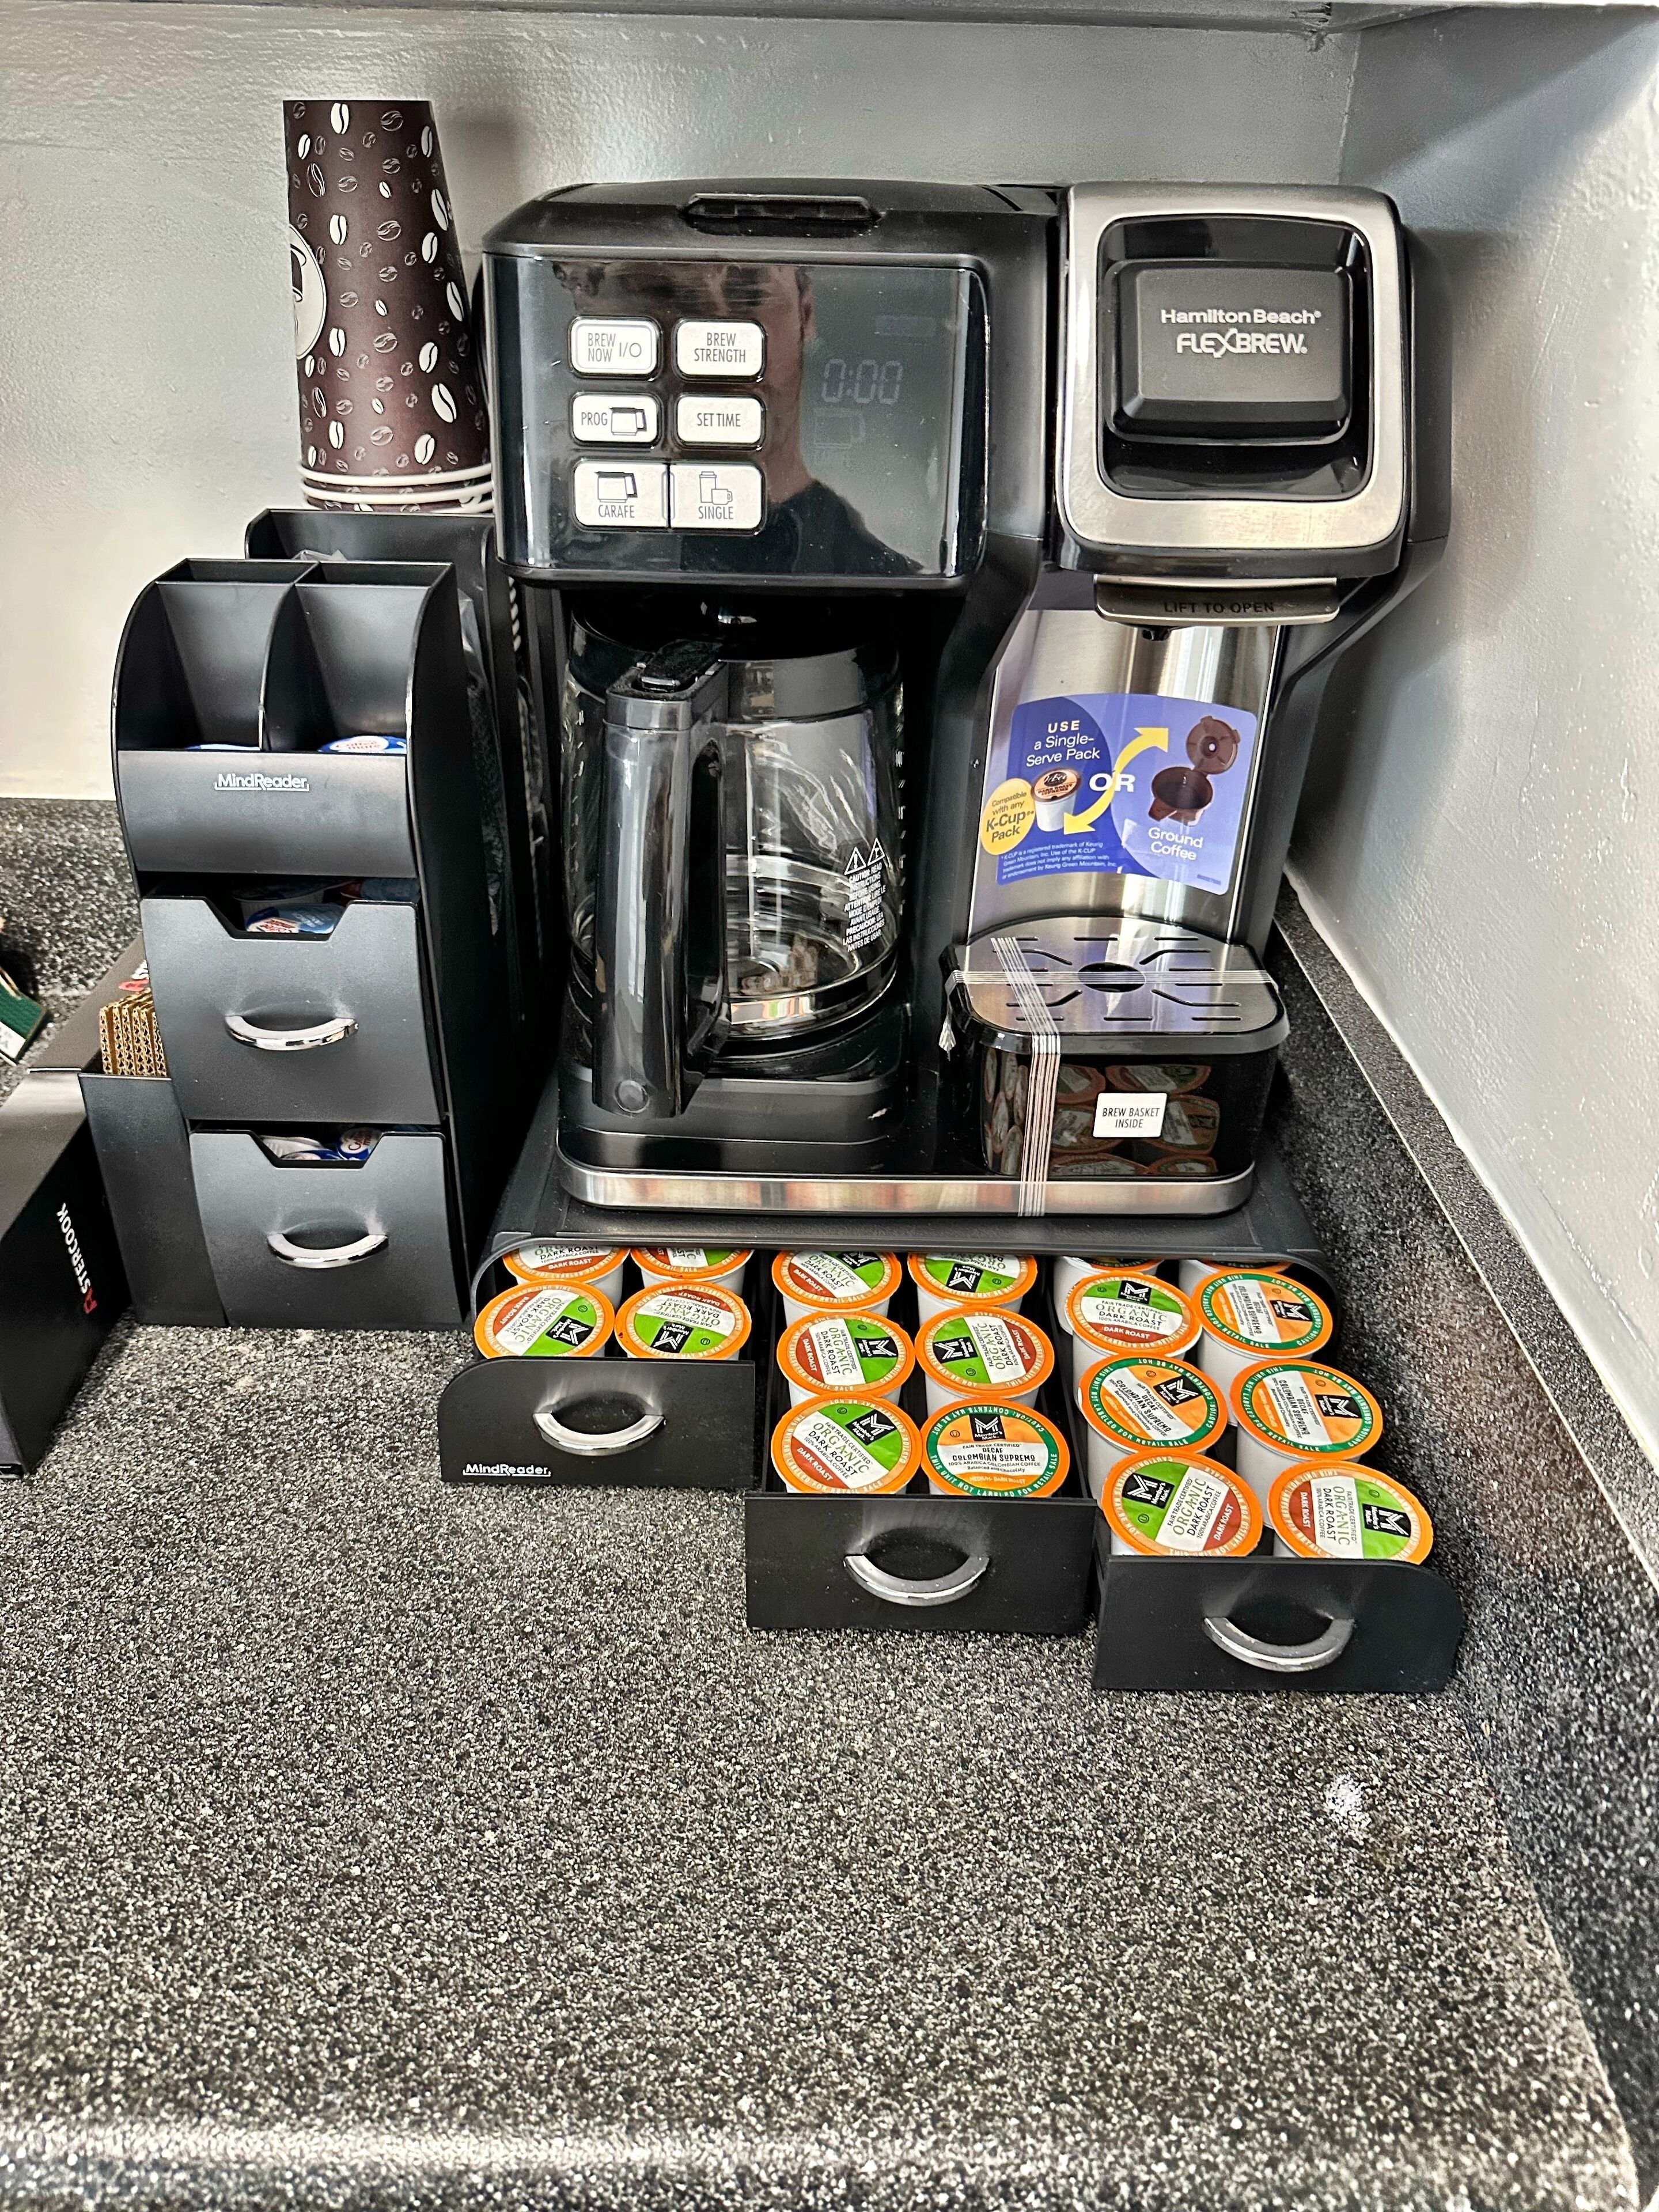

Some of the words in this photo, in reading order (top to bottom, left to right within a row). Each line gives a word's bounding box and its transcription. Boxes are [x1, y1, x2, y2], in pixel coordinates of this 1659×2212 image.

[1161, 309, 1251, 323] Hamilton
[588, 333, 616, 347] BREW
[707, 332, 736, 346] BREW
[588, 349, 612, 362] NOW
[694, 348, 745, 362] STRENGTH
[581, 411, 608, 426] PROG
[697, 413, 714, 426] SET
[715, 413, 741, 427] TIME
[598, 505, 635, 518] CARAFE
[698, 506, 733, 519] SINGLE
[1164, 602, 1196, 613] LIFT
[1203, 603, 1225, 613] TO
[1230, 602, 1274, 613] OPEN
[1048, 720, 1080, 733] USE
[1034, 741, 1041, 750] a
[1046, 733, 1094, 748] Single-
[1027, 752, 1062, 767] Serve
[1066, 748, 1100, 760] Pack
[218, 773, 308, 791] MindReader
[1089, 773, 1135, 792] OR
[992, 791, 1027, 806] Compatible
[992, 805, 1009, 816] with
[1010, 800, 1025, 810] any
[991, 825, 1021, 843] Pack
[1149, 827, 1203, 848] Ground
[1151, 841, 1196, 860] Coffee
[850, 872, 881, 892] INSTRUCTIONS
[850, 914, 865, 926] AVANT
[866, 906, 880, 919] USAGE
[843, 935, 853, 945] LAS
[848, 940, 863, 952] ANTES
[864, 937, 870, 945] DE
[1103, 1108, 1127, 1117] BREW
[1128, 1108, 1160, 1117] BASKET
[1115, 1119, 1143, 1128] INSIDE
[56, 1202, 91, 1294] STERCOOK
[548, 1262, 568, 1270] DARK
[569, 1258, 592, 1266] ROAST
[793, 1269, 808, 1281] DARK
[806, 1278, 824, 1291] ROAST
[805, 1260, 820, 1272] DARK
[821, 1268, 844, 1287] ROAST
[514, 1296, 529, 1310] DARK
[533, 1298, 551, 1313] DARK
[662, 1301, 692, 1310] ROAST
[499, 1308, 517, 1325] ROAST
[695, 1308, 719, 1319] DARK
[1129, 1315, 1162, 1326] ROAST
[510, 1314, 533, 1336] ROAST
[989, 1325, 1004, 1344] ROAST
[1012, 1330, 1022, 1345] ROAST
[1125, 1330, 1150, 1339] ROAST
[802, 1338, 812, 1354] DARK
[807, 1354, 817, 1372] ROAST
[820, 1331, 831, 1347] DARK
[827, 1349, 840, 1374] ROAST
[1002, 1346, 1013, 1366] DARK
[1018, 1346, 1031, 1359] DARK
[968, 1406, 1009, 1414] CONTENTS
[1116, 1380, 1146, 1409] COLOMBIAN
[1144, 1408, 1172, 1432] SUPREMO
[1142, 1395, 1158, 1411] DECAF
[1279, 1380, 1298, 1408] COLOMBIAN
[1293, 1408, 1310, 1435] SUPREMO
[1297, 1399, 1309, 1414] DECAF
[943, 1416, 952, 1424] BE
[952, 1407, 966, 1418] MAY
[825, 1422, 836, 1430] FAIR
[834, 1429, 850, 1445] TRADE
[931, 1423, 944, 1435] HOT
[974, 1430, 1003, 1438] Member's
[804, 1437, 815, 1446] 100%
[814, 1445, 834, 1463] ARABICA
[832, 1462, 850, 1479] COFFEE
[809, 1431, 832, 1451] DARK
[830, 1450, 858, 1475] ROAST
[465, 1464, 548, 1476] MindReader
[797, 1447, 813, 1463] DARK
[812, 1461, 834, 1482] ROAST
[930, 1454, 942, 1470] THIS
[940, 1469, 957, 1485] UNIT
[957, 1482, 974, 1493] NOT
[1017, 1487, 1033, 1496] FOR
[1033, 1470, 1054, 1490] RETAIL
[1050, 1453, 1058, 1471] SALE
[1300, 1492, 1309, 1508] DARK
[1323, 1488, 1334, 1509] DARK
[1187, 1512, 1203, 1536] DARK
[1200, 1486, 1215, 1512] ROAST
[1301, 1509, 1311, 1528] ROAST
[1213, 1522, 1228, 1541] DARK
[1221, 1503, 1234, 1524] ROAST
[1326, 1510, 1336, 1541] ROAST
